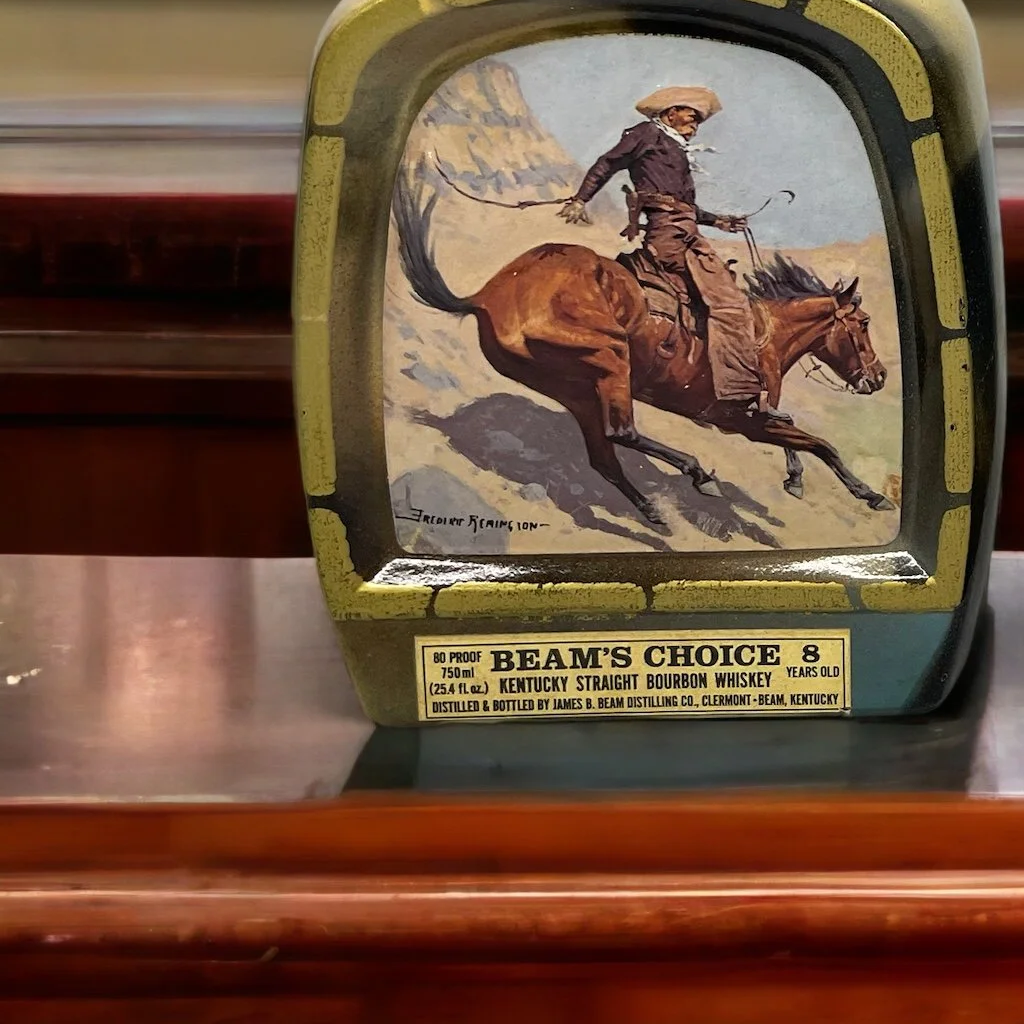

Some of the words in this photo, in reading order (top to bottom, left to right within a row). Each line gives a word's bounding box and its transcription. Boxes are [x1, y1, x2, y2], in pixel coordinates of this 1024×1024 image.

[433, 652, 446, 664] 80
[449, 651, 482, 663] PROOF
[490, 646, 633, 672] BEAM'S
[643, 644, 780, 668] CHOICE
[802, 644, 820, 663] 8
[786, 666, 818, 678] YEARS
[820, 666, 840, 678] OLD
[429, 682, 455, 696] (25.4
[499, 676, 568, 694] KENTUCKY
[576, 674, 639, 692] STRAIGHT
[646, 672, 708, 690] BOURBON
[715, 671, 772, 689] WHISKEY
[432, 701, 480, 713] DISTILLED
[482, 700, 490, 711] &
[493, 699, 535, 711] BOTTLED
[537, 699, 550, 710] BY
[552, 698, 583, 710] JAMES
[585, 698, 596, 709] B.
[598, 697, 625, 709] BEAM
[627, 696, 678, 708] DISTILLING
[790, 693, 839, 705] KENTUCKY
